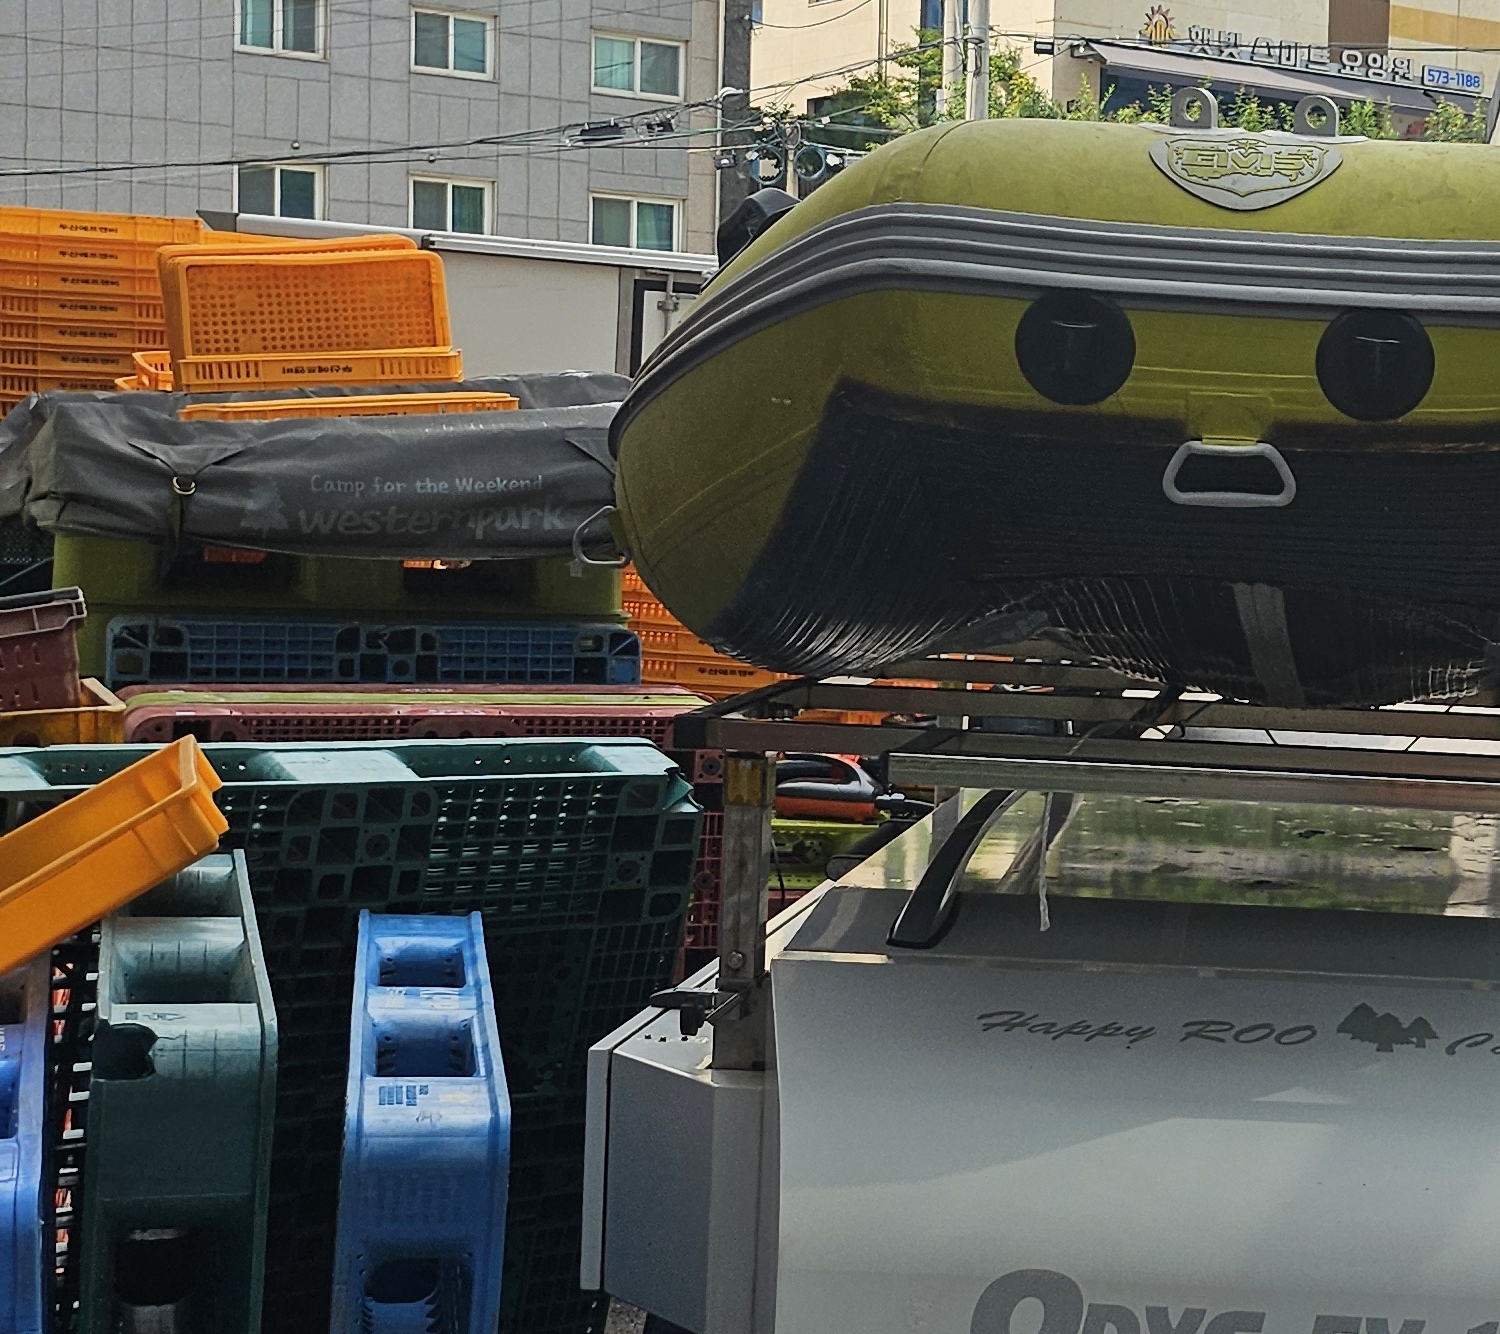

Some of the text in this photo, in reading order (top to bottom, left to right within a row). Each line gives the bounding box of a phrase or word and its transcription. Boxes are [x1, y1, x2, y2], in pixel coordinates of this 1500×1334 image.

[1340, 49, 1416, 83] 요양원
[1426, 67, 1482, 89] 573-1188
[310, 474, 543, 498] Camp for the Weekend
[976, 1009, 1157, 1043] Happy
[1180, 1020, 1319, 1046] ROO
